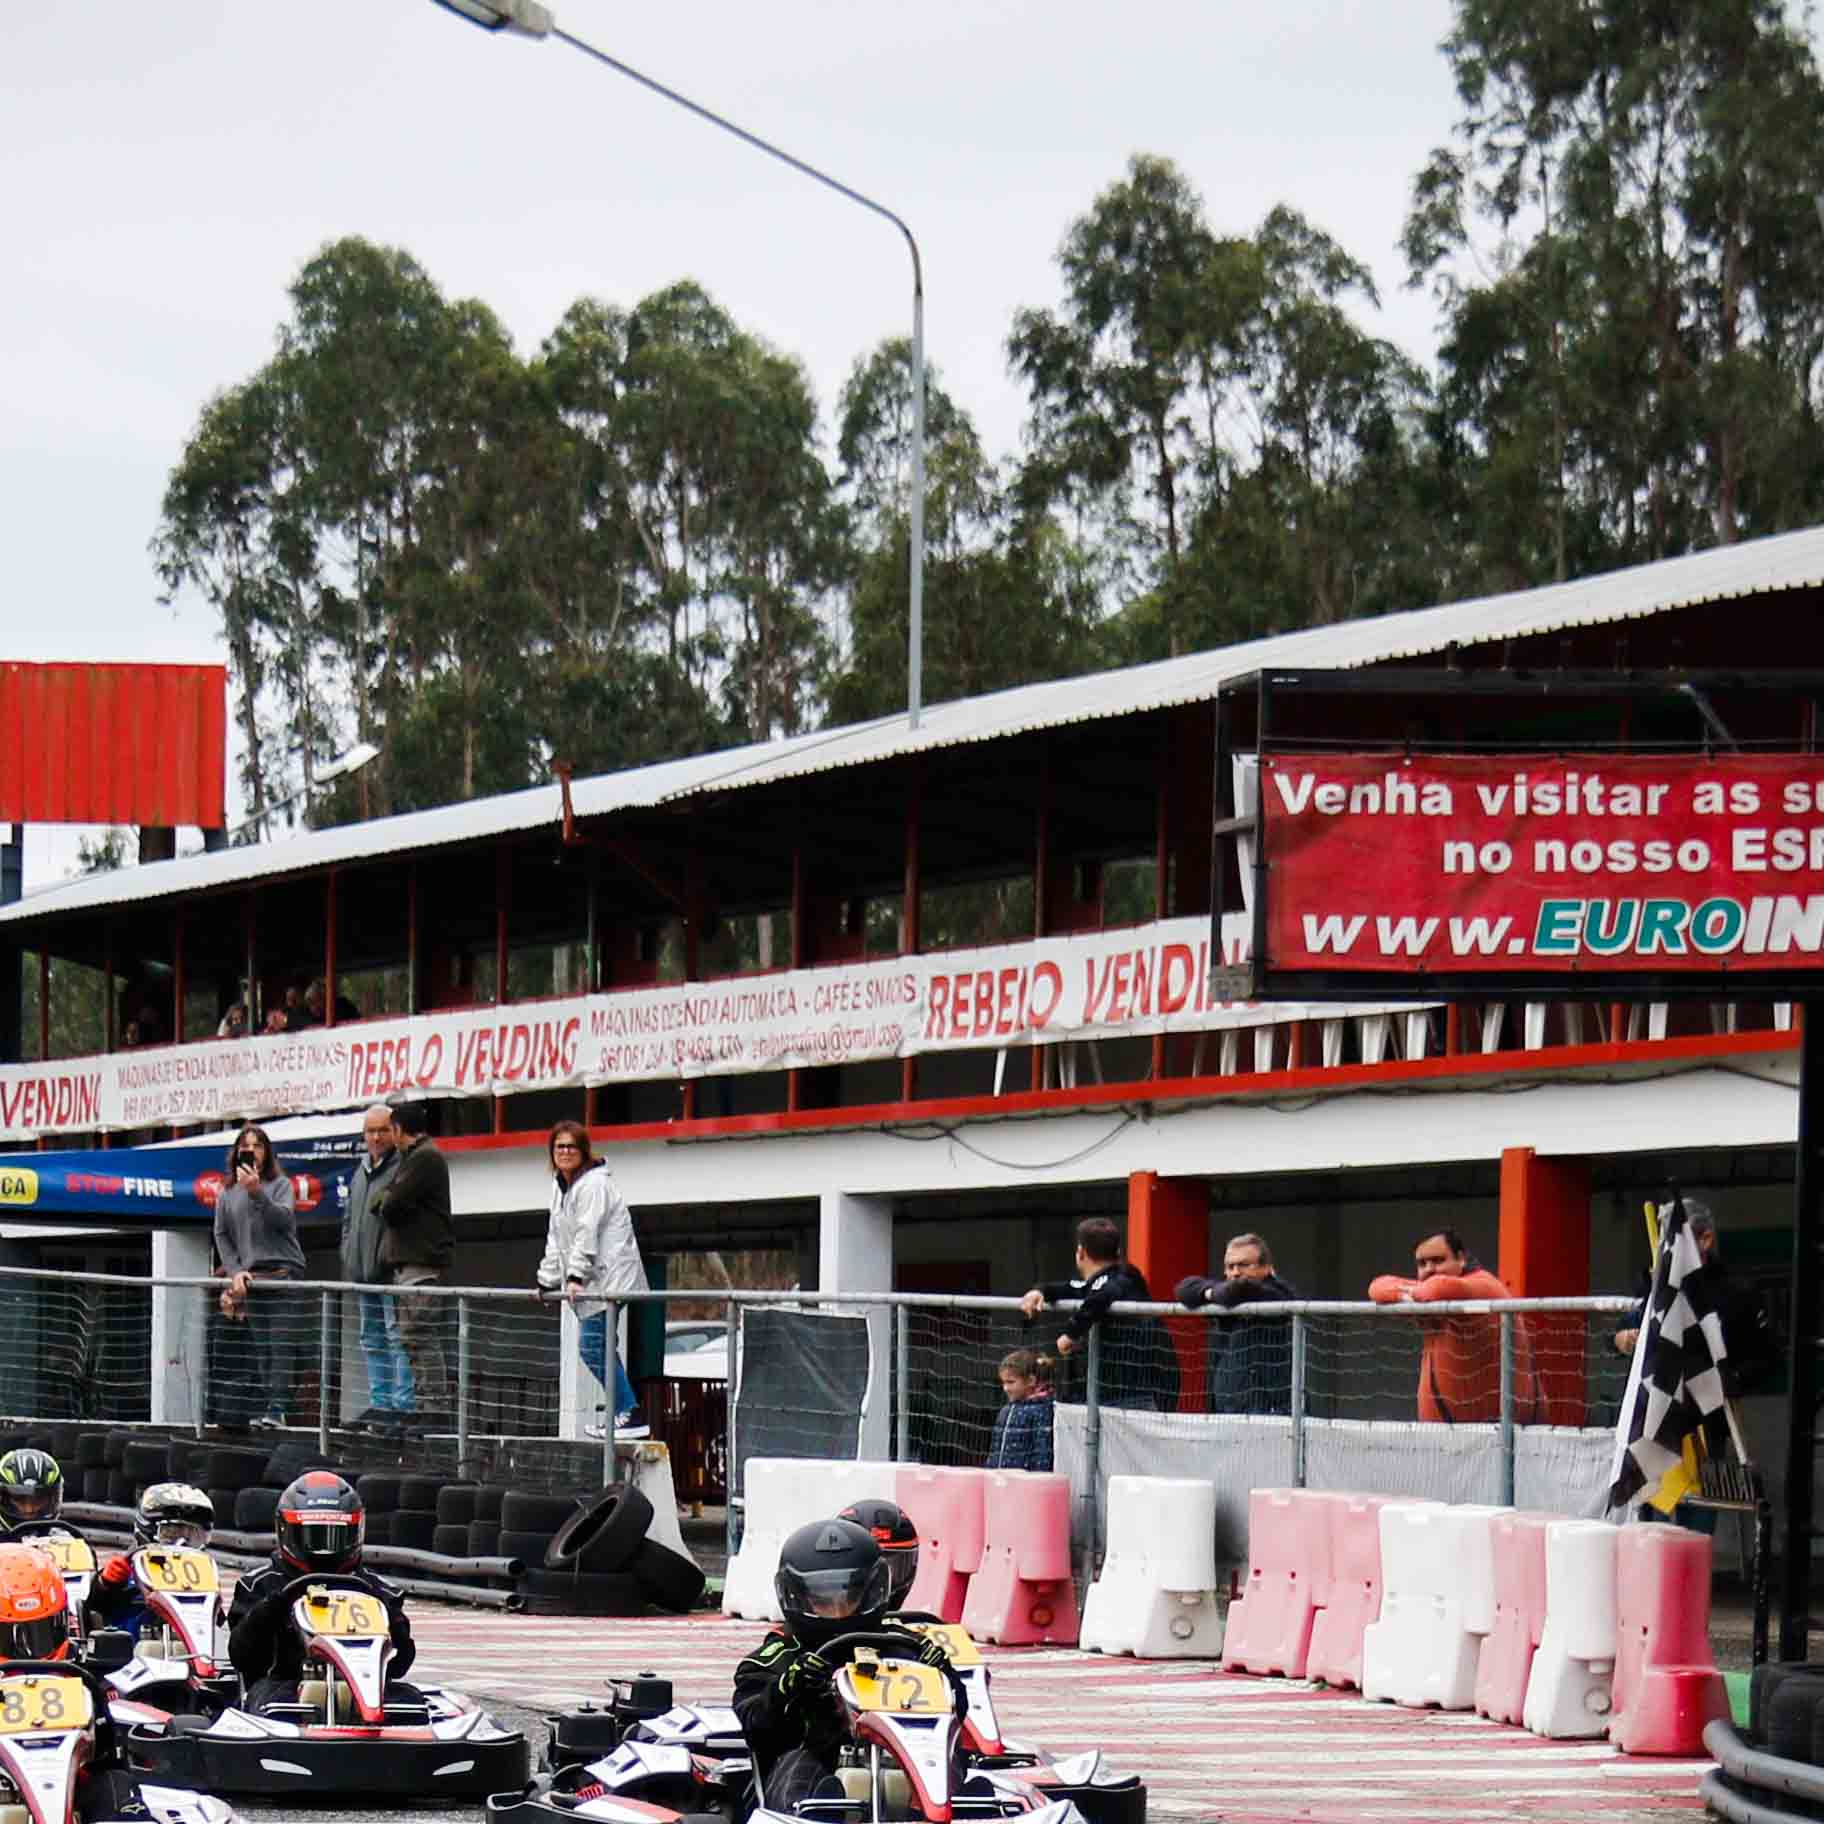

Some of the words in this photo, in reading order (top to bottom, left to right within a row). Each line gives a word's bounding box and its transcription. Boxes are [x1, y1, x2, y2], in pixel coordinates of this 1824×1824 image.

[1273, 773, 1454, 816] Venha
[1476, 772, 1670, 816] visitar
[1692, 781, 1761, 815] as
[1442, 840, 1514, 874] no
[1533, 839, 1711, 874] nosso
[162, 1558, 201, 1585] 80
[327, 1603, 371, 1629] 76
[2, 1687, 65, 1724] 88
[877, 1674, 931, 1707] 72
